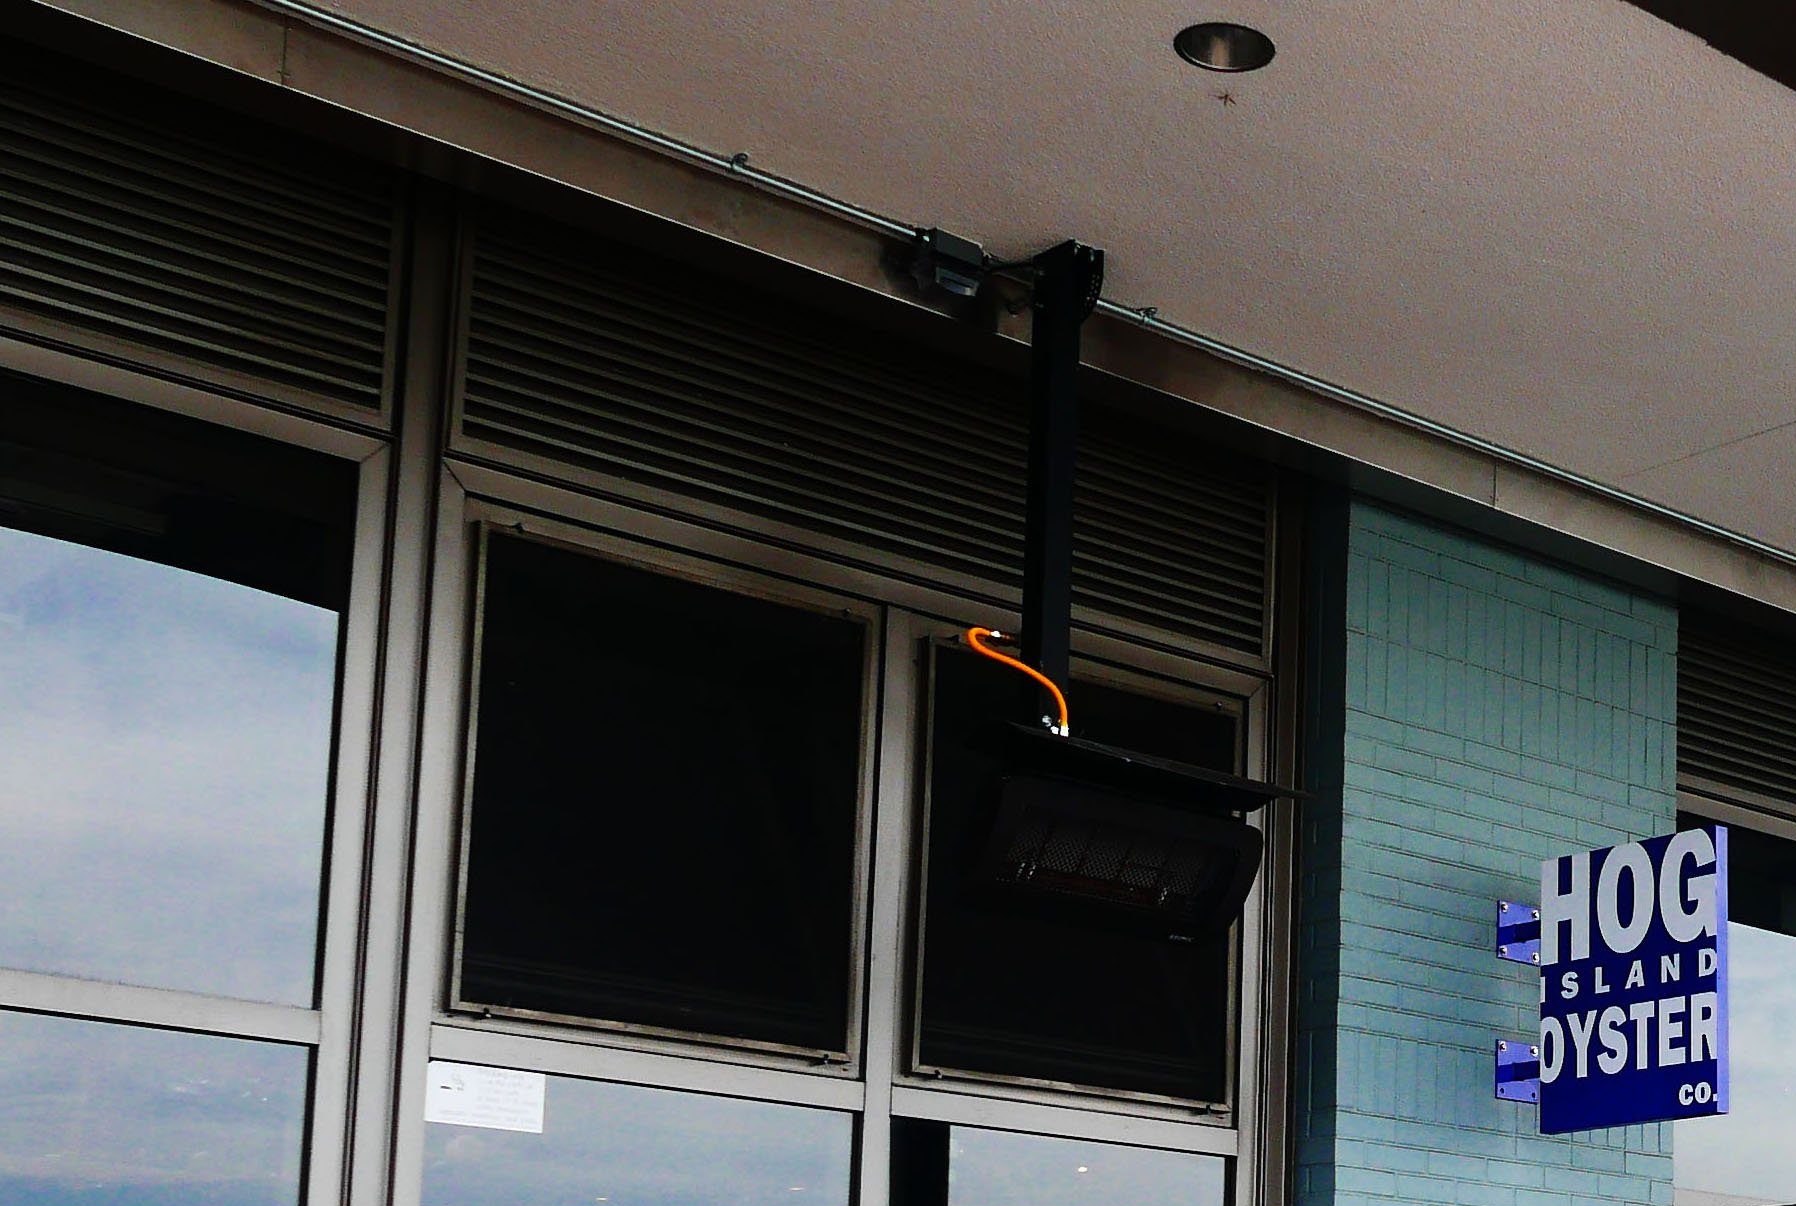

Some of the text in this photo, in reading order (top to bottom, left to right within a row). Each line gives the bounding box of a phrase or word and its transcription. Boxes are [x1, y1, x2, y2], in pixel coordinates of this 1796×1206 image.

[1540, 828, 1717, 966] HOG
[1540, 947, 1718, 1004] ISLAND
[1540, 992, 1718, 1084] OYSTER
[1678, 1081, 1719, 1106] CO.
